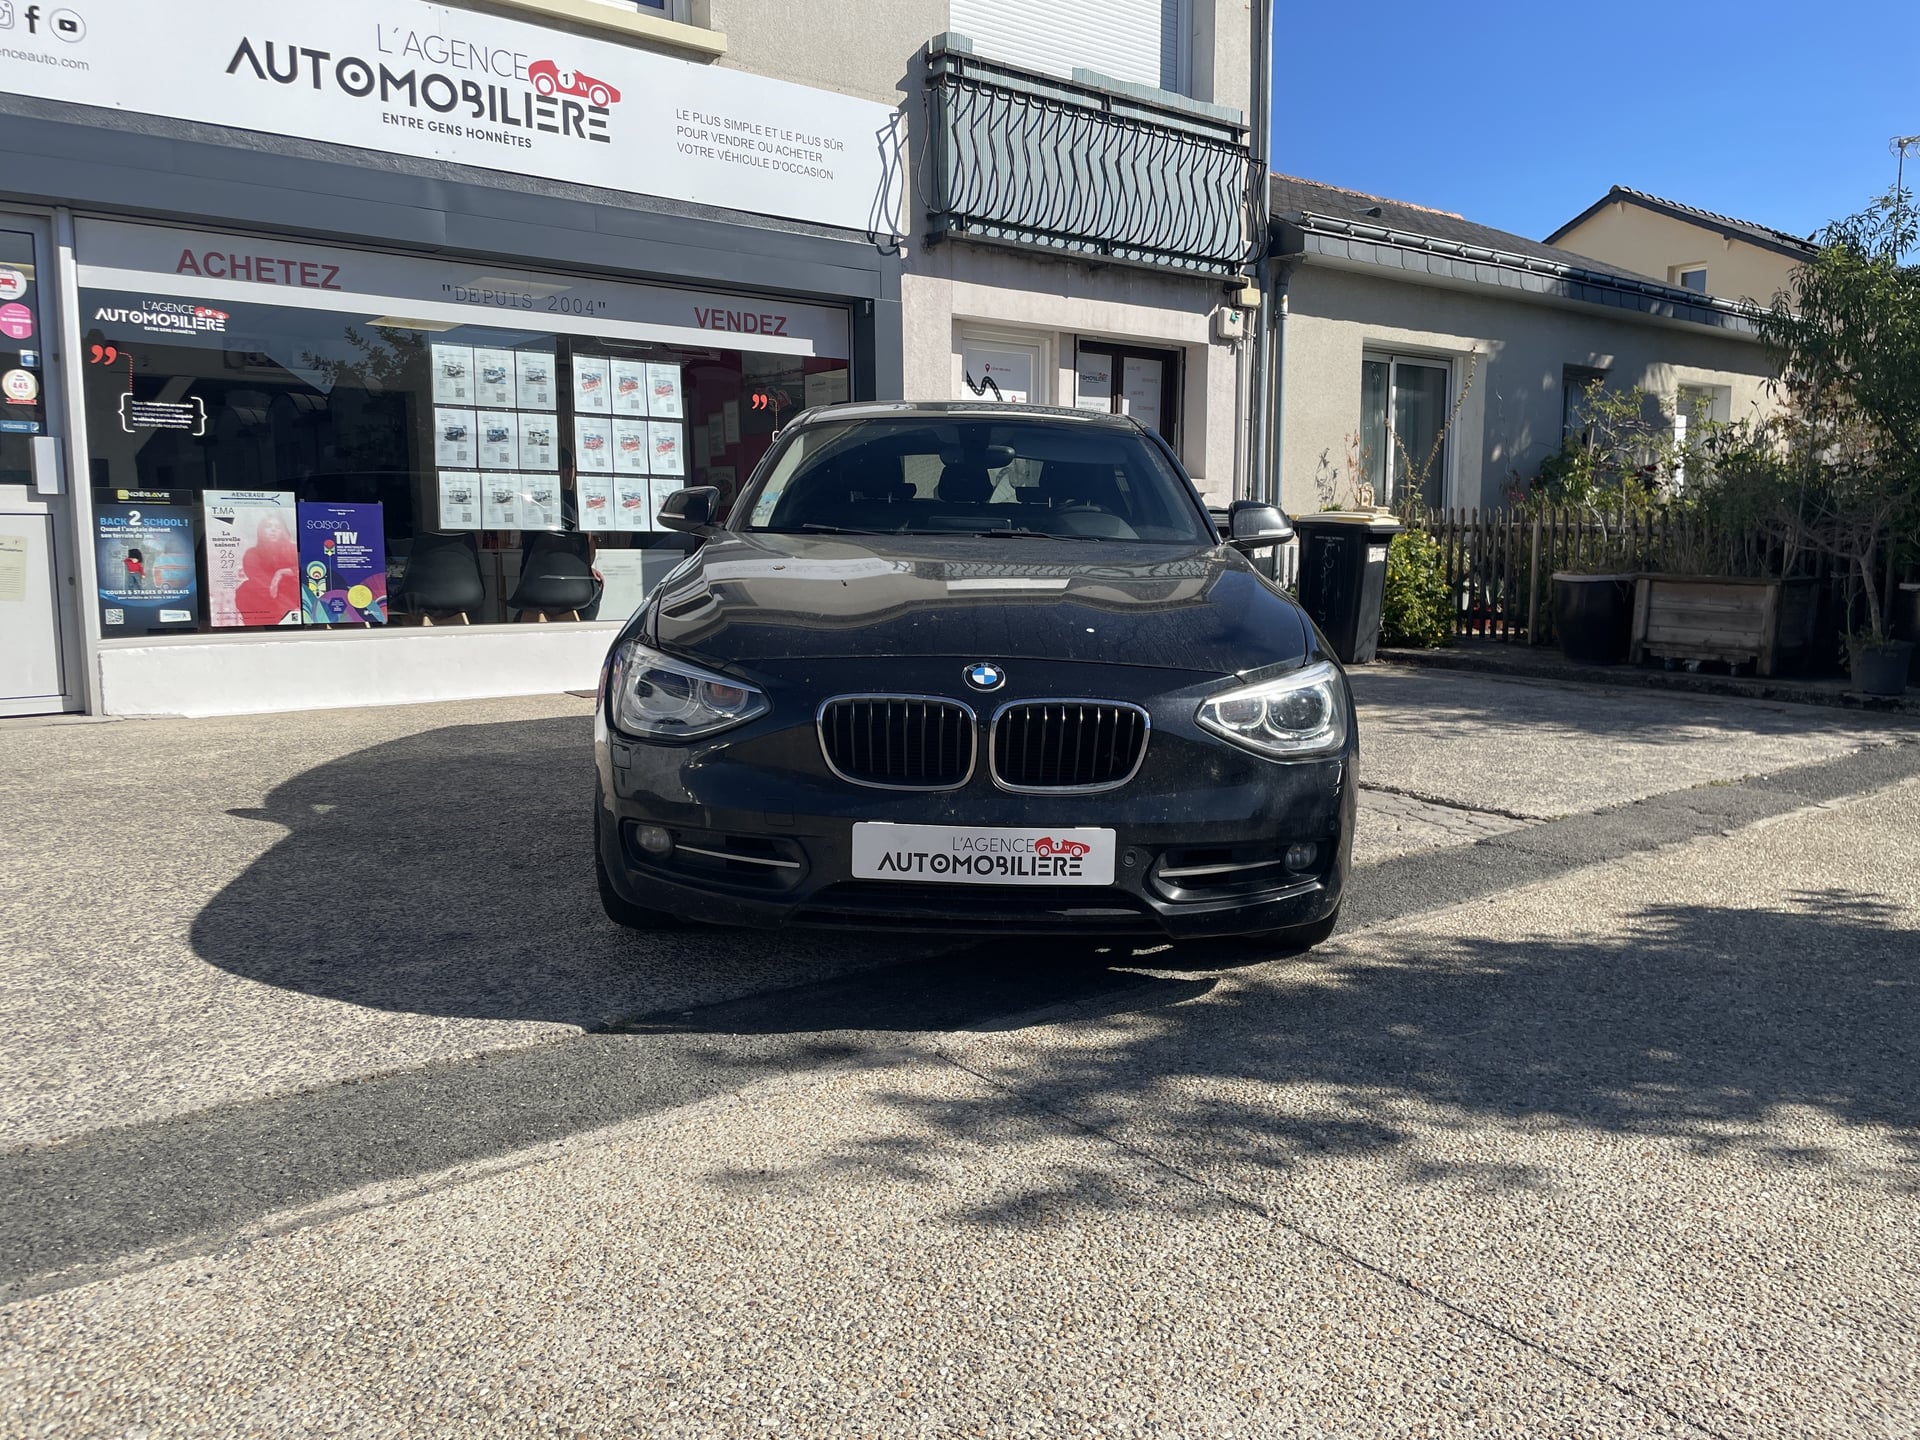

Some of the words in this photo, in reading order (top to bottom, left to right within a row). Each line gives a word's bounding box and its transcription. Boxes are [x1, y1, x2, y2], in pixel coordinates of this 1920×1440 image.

[377, 23, 529, 81] L'AGENCE
[383, 113, 424, 130] ENTRE
[428, 121, 462, 136] GENS
[467, 128, 532, 149] HONNÊTES
[676, 108, 689, 121] LE
[693, 112, 721, 127] PLUS
[724, 118, 762, 135] SIMPLE
[765, 127, 778, 138] ET
[780, 130, 793, 141] LE
[795, 133, 821, 147] PLUS
[823, 138, 844, 151] SÛR
[677, 125, 709, 141] POUR
[711, 132, 755, 149] VENDRE
[758, 142, 773, 153] OU
[775, 145, 823, 163] ACHETER
[677, 142, 714, 158] VOTRE
[717, 149, 770, 169] VÉHICULE
[772, 160, 834, 181] D'OCCASION
[176, 249, 342, 290] ACHETEZ
[142, 300, 195, 314] L'AGENCE
[694, 306, 787, 337] VENDEZ
[100, 517, 127, 526] BACK
[128, 510, 142, 526] 2
[334, 531, 358, 545] THV
[220, 549, 235, 559] 26
[220, 560, 235, 569] 27
[952, 836, 1036, 853] L'AGENCE
